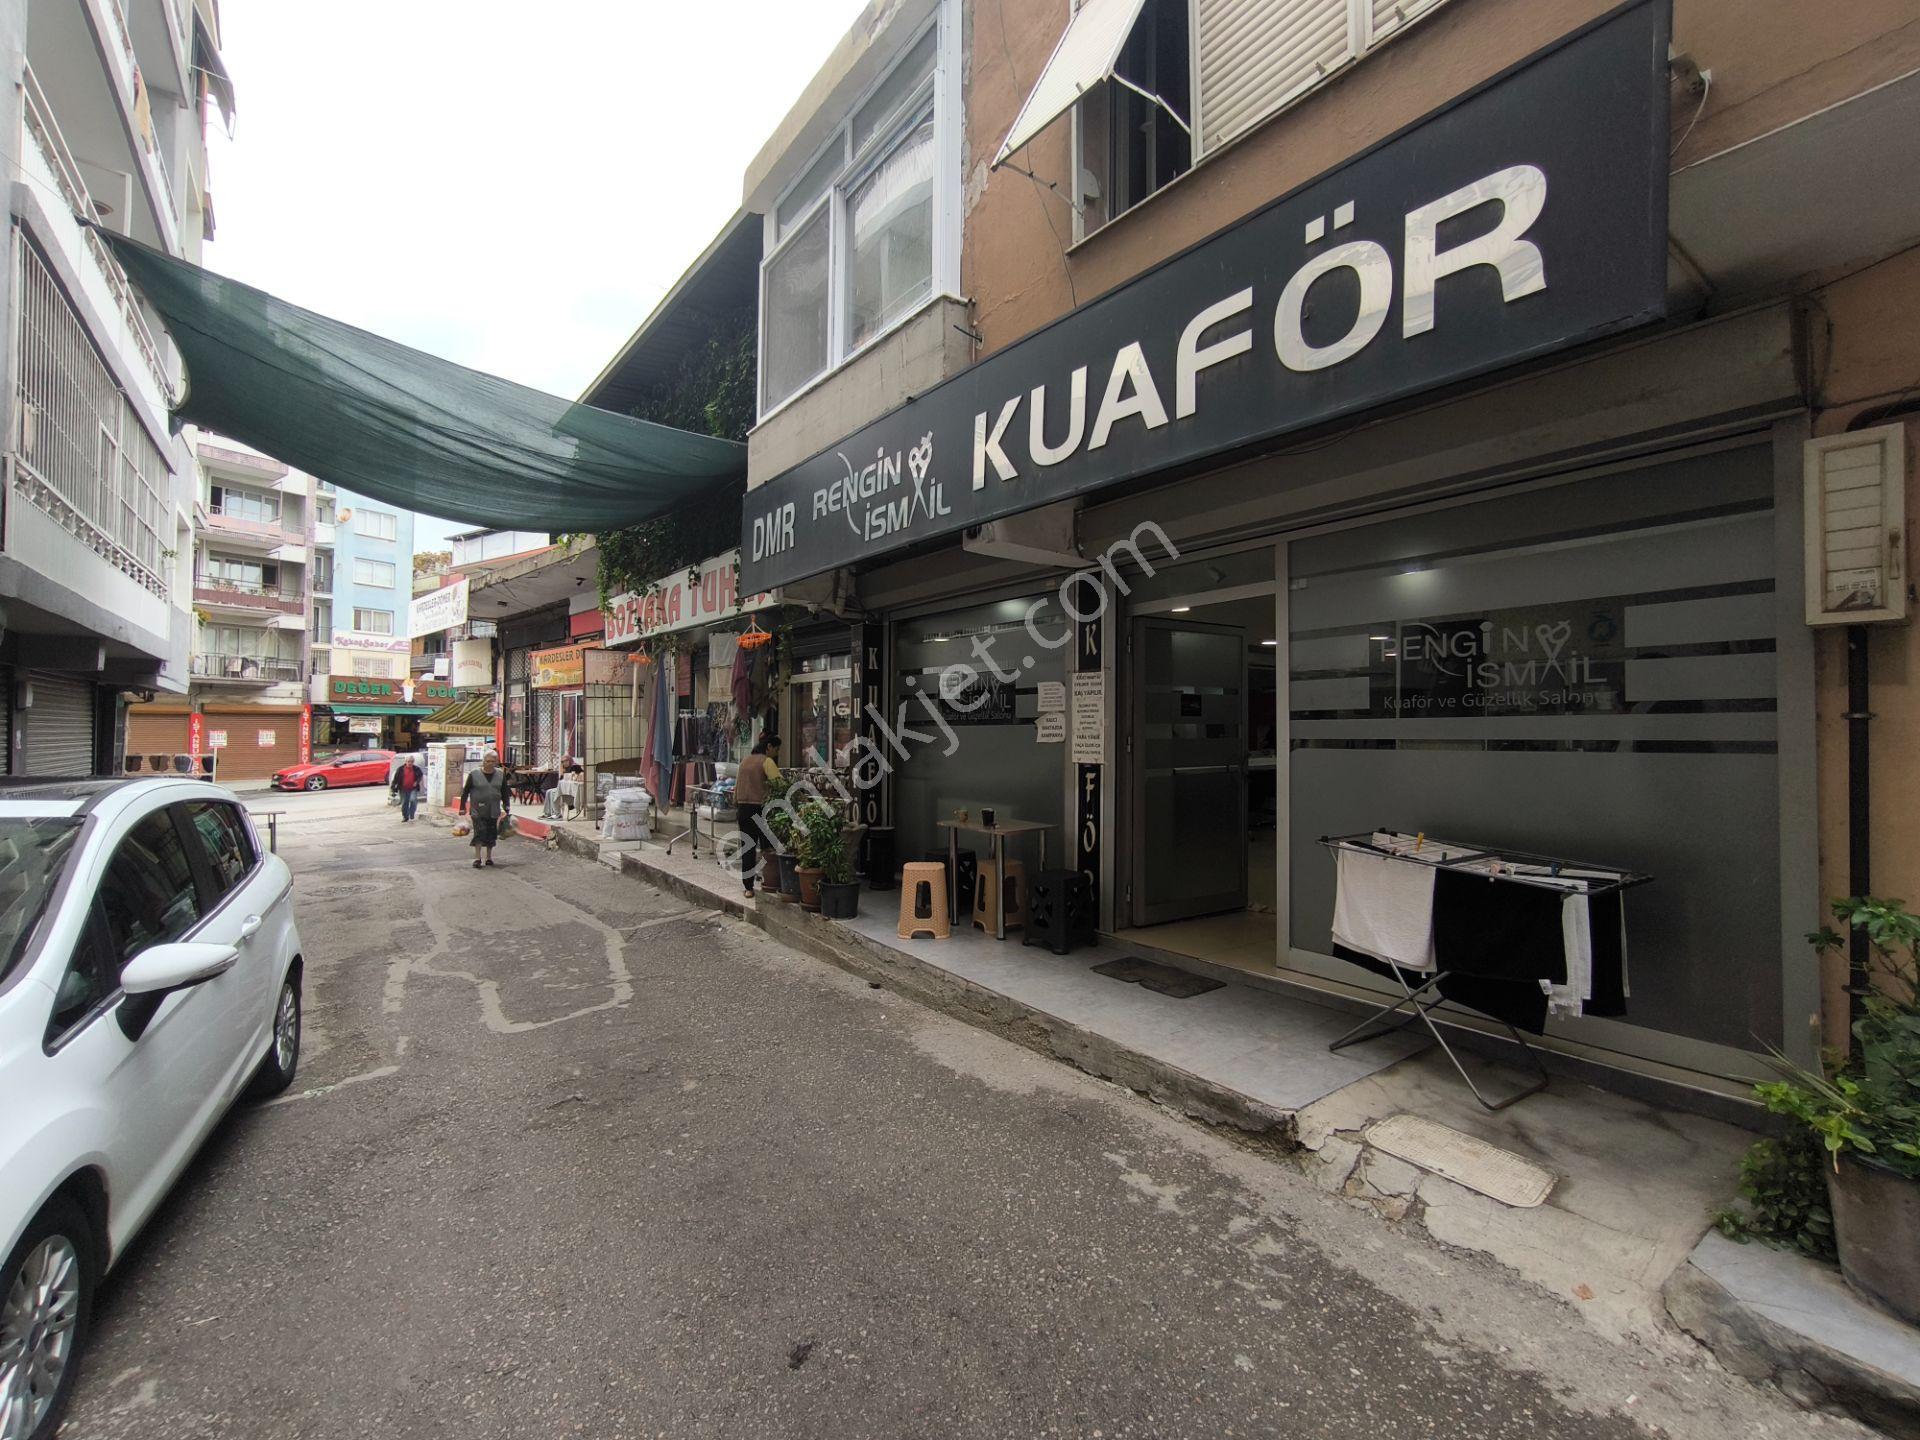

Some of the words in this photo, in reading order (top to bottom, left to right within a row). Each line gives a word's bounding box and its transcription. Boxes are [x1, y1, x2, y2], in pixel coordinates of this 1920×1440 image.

[972, 164, 1547, 491] KUAFÖR
[812, 446, 901, 521] RENGİN
[752, 502, 795, 562] DMR
[1438, 697, 1457, 708] ve
